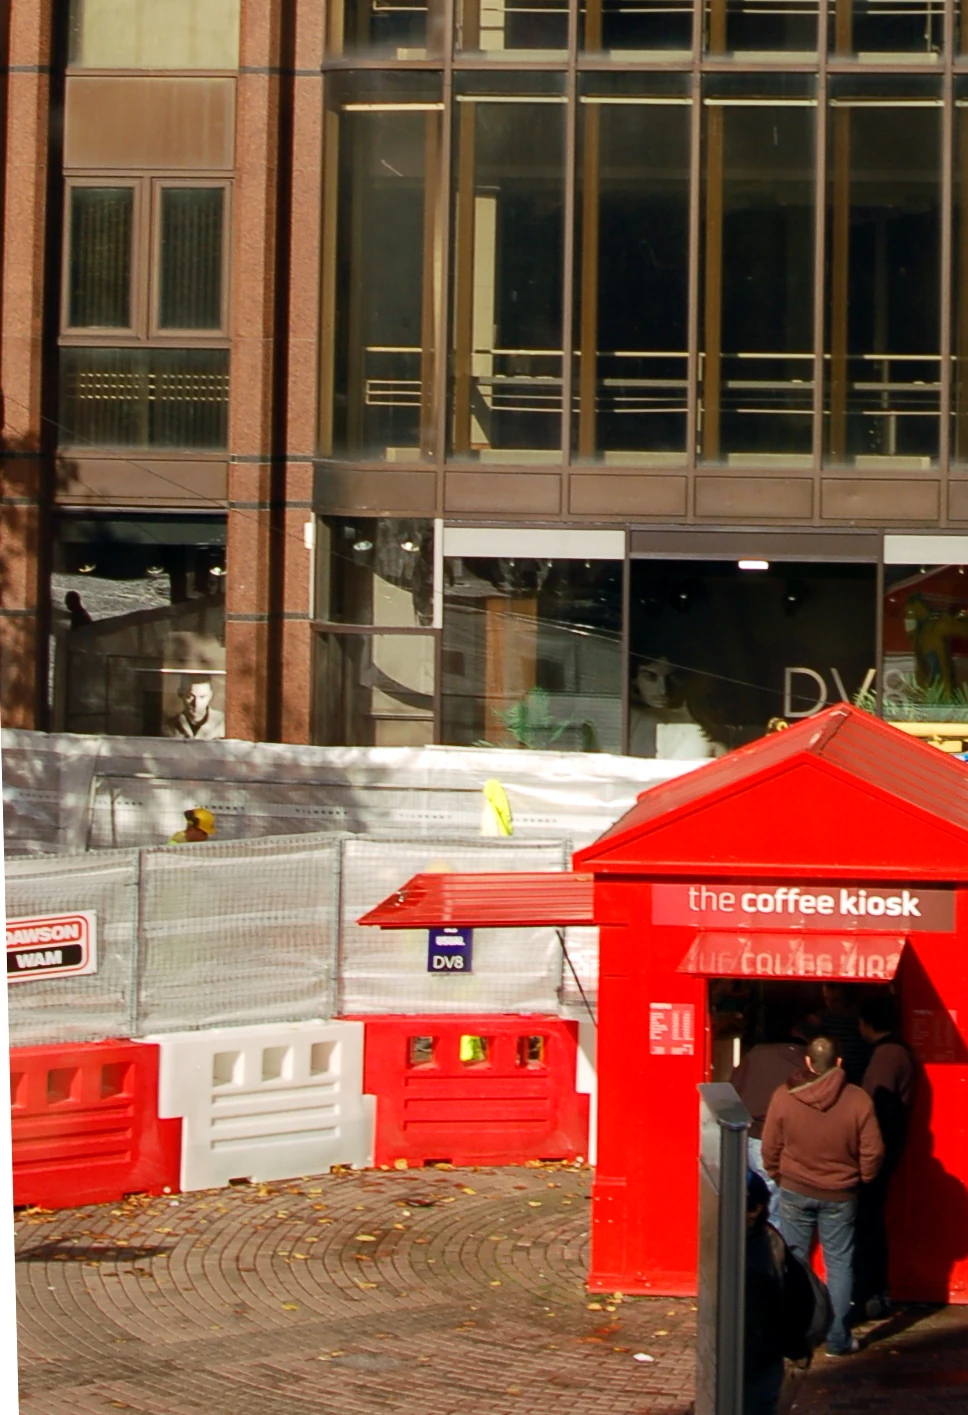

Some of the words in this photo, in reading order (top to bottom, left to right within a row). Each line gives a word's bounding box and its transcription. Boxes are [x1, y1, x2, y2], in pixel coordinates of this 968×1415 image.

[688, 885, 735, 913] the
[741, 887, 835, 915] coffee
[840, 888, 922, 917] kiosk
[16, 950, 63, 968] WAM
[432, 955, 464, 969] DV8
